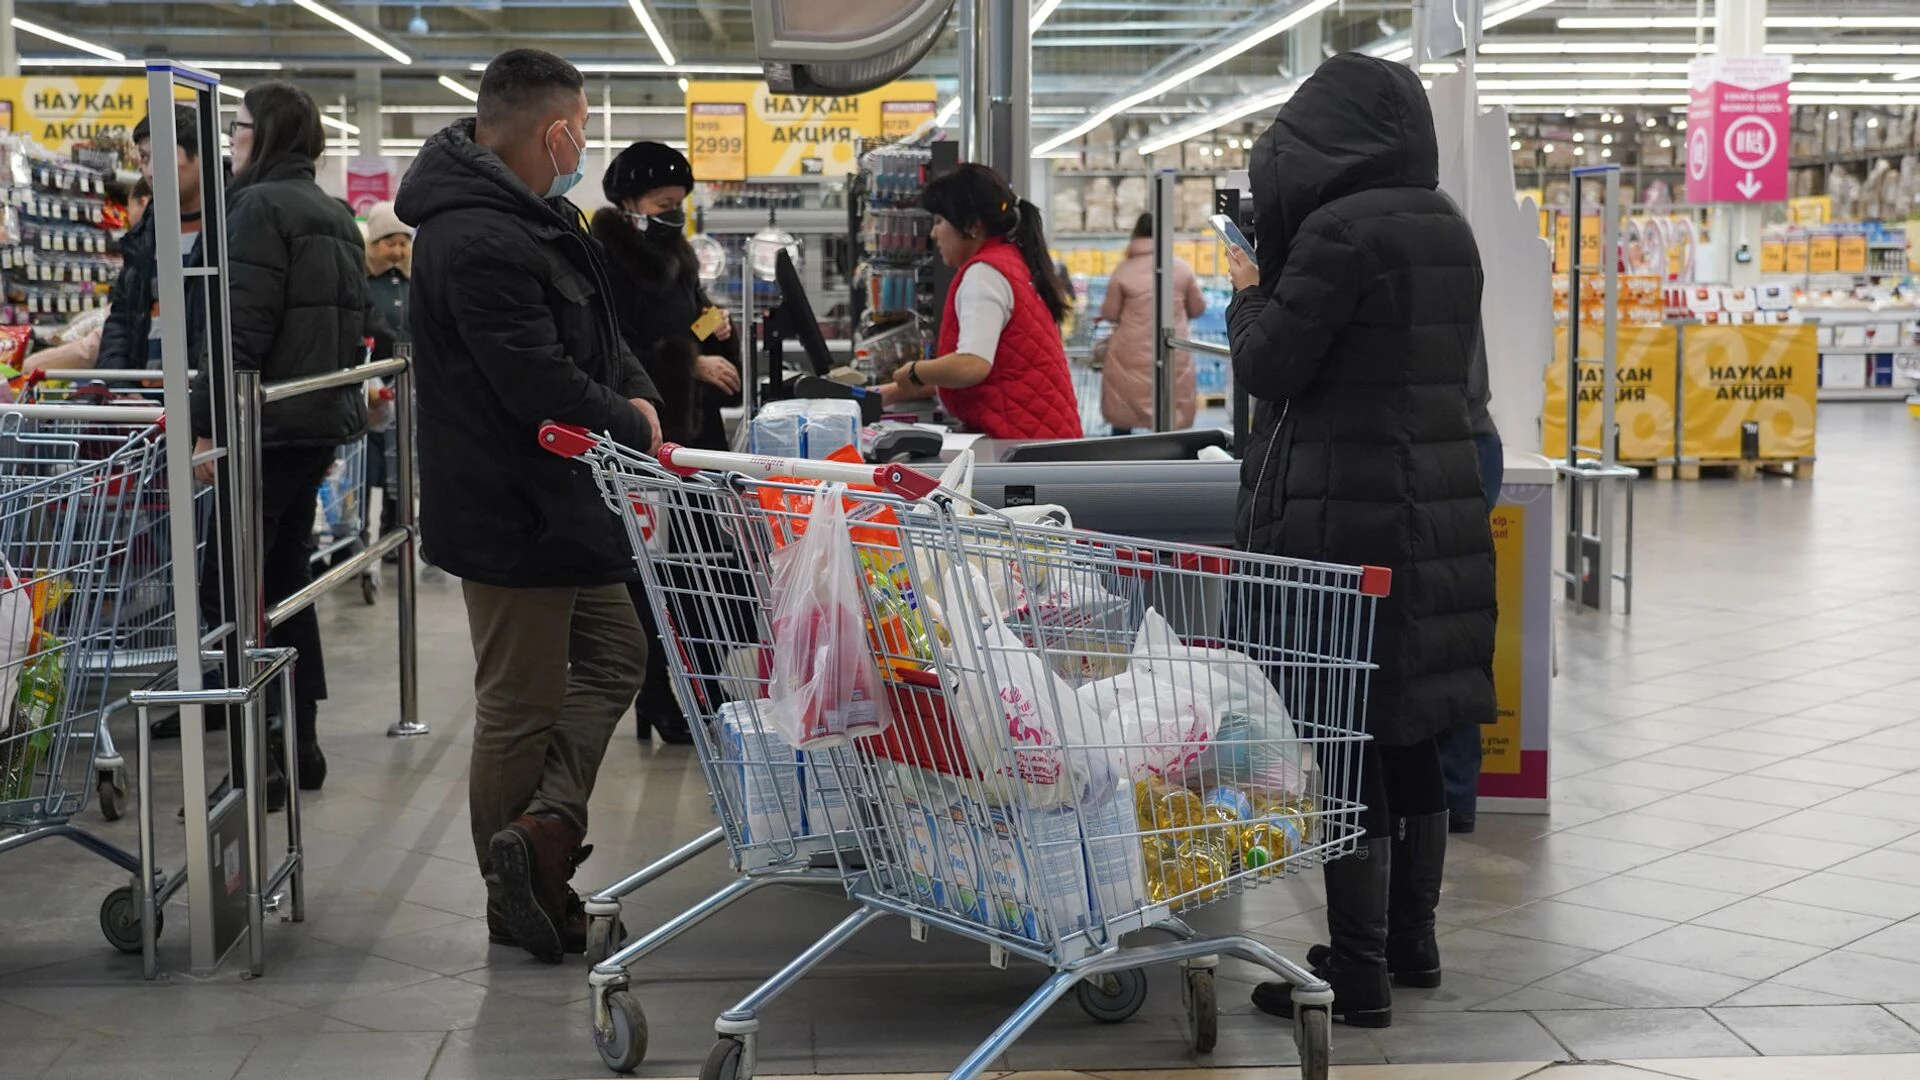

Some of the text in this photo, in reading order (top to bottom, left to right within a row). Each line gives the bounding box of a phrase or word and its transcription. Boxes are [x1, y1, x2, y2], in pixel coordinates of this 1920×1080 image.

[772, 126, 851, 145] АКЦИЯ
[695, 136, 741, 154] 2999
[1577, 387, 1646, 403] АКИЯ
[1716, 384, 1785, 403] АКЦИЯ
